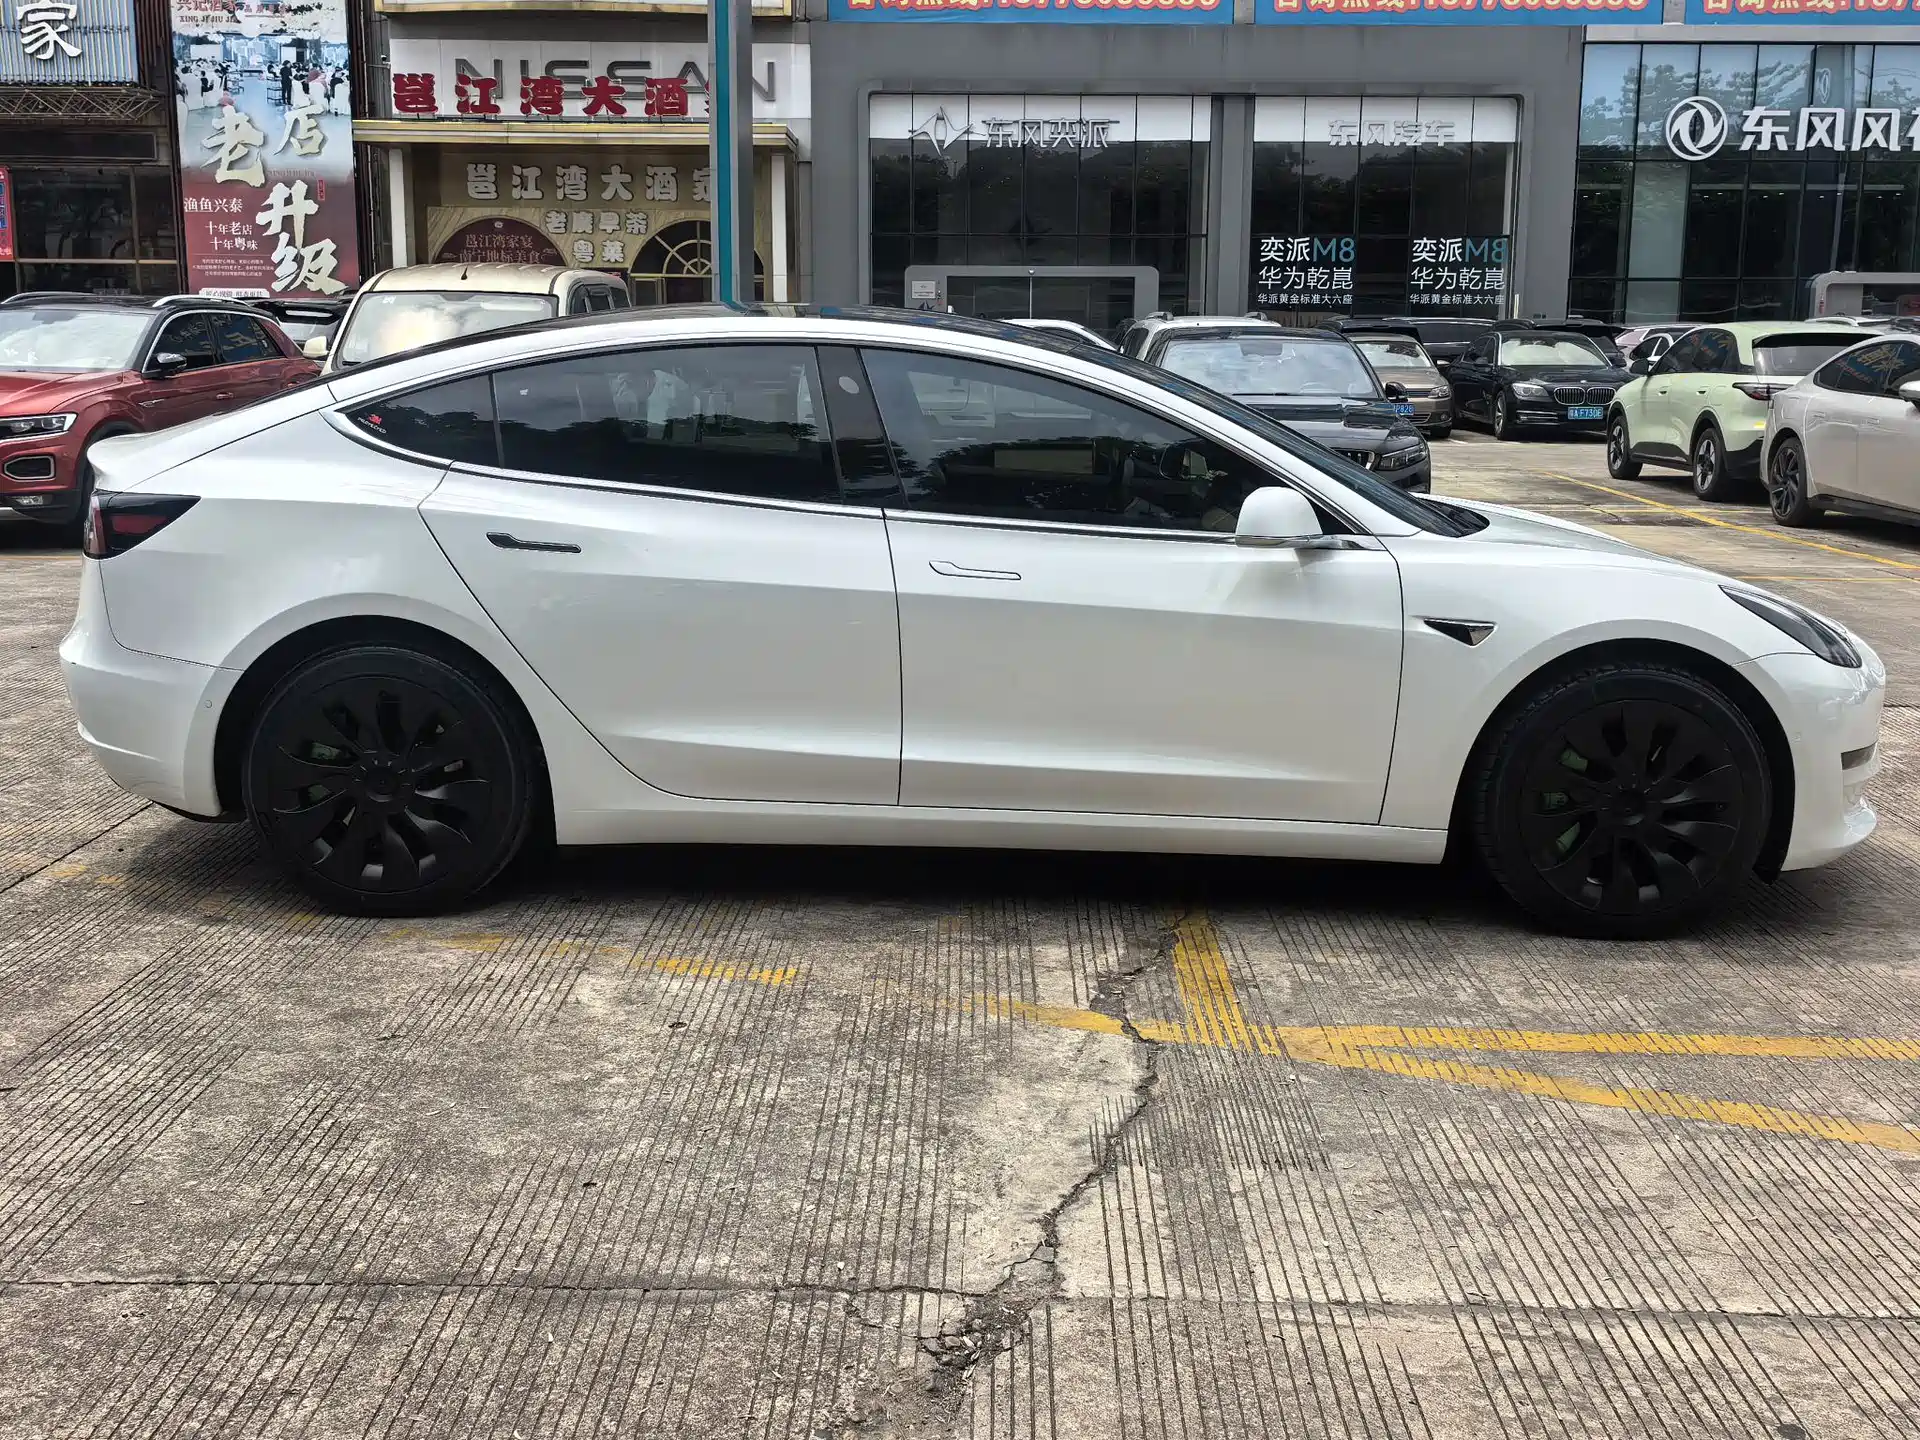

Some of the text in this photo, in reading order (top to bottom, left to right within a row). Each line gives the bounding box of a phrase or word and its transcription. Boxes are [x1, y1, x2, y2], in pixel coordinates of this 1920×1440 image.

[16, 0, 82, 59] 家
[392, 72, 709, 115] 邕江湾大酒
[982, 117, 1109, 148] 东风奕派
[1328, 119, 1455, 147] 东风汽车
[205, 221, 253, 235] 十年老店
[209, 236, 258, 251] 十年粤味
